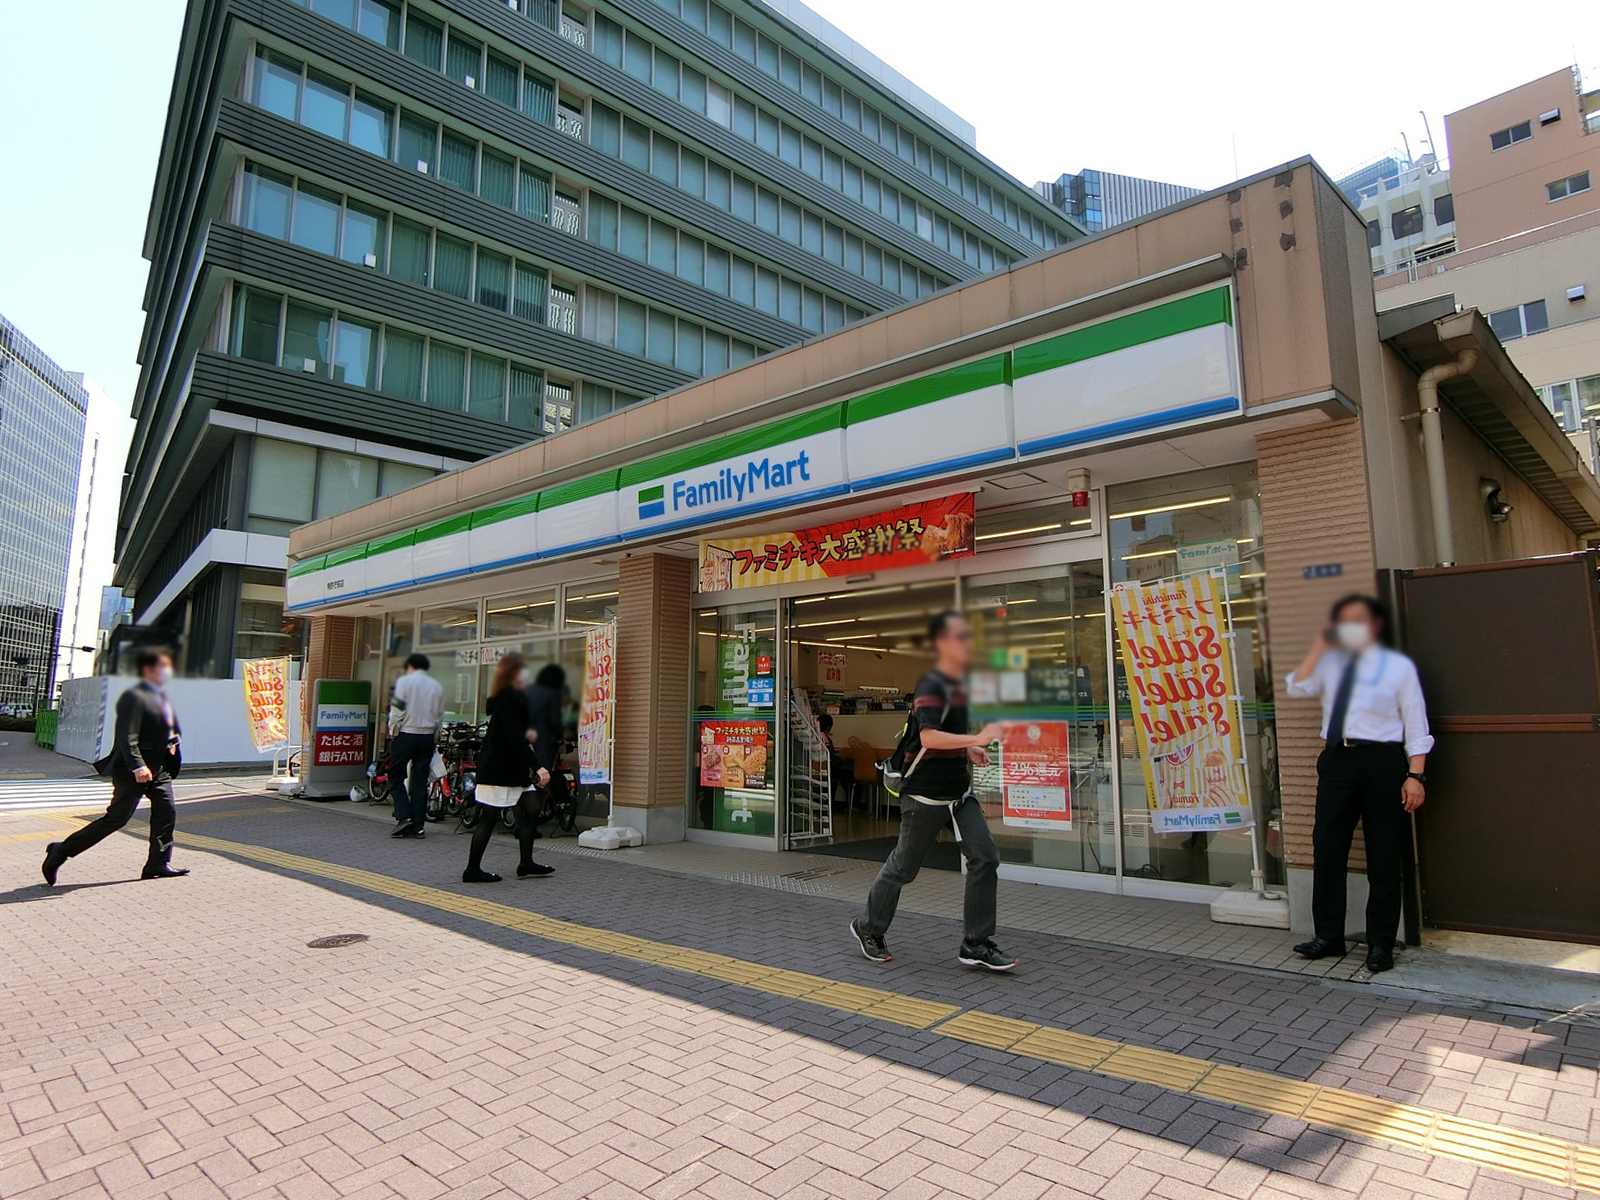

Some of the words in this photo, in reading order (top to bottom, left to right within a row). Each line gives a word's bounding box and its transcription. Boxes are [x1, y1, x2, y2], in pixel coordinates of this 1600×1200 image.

[673, 450, 810, 511] FamilyMart
[321, 711, 366, 721] FamilyMart
[319, 750, 364, 762] 銀行ATM
